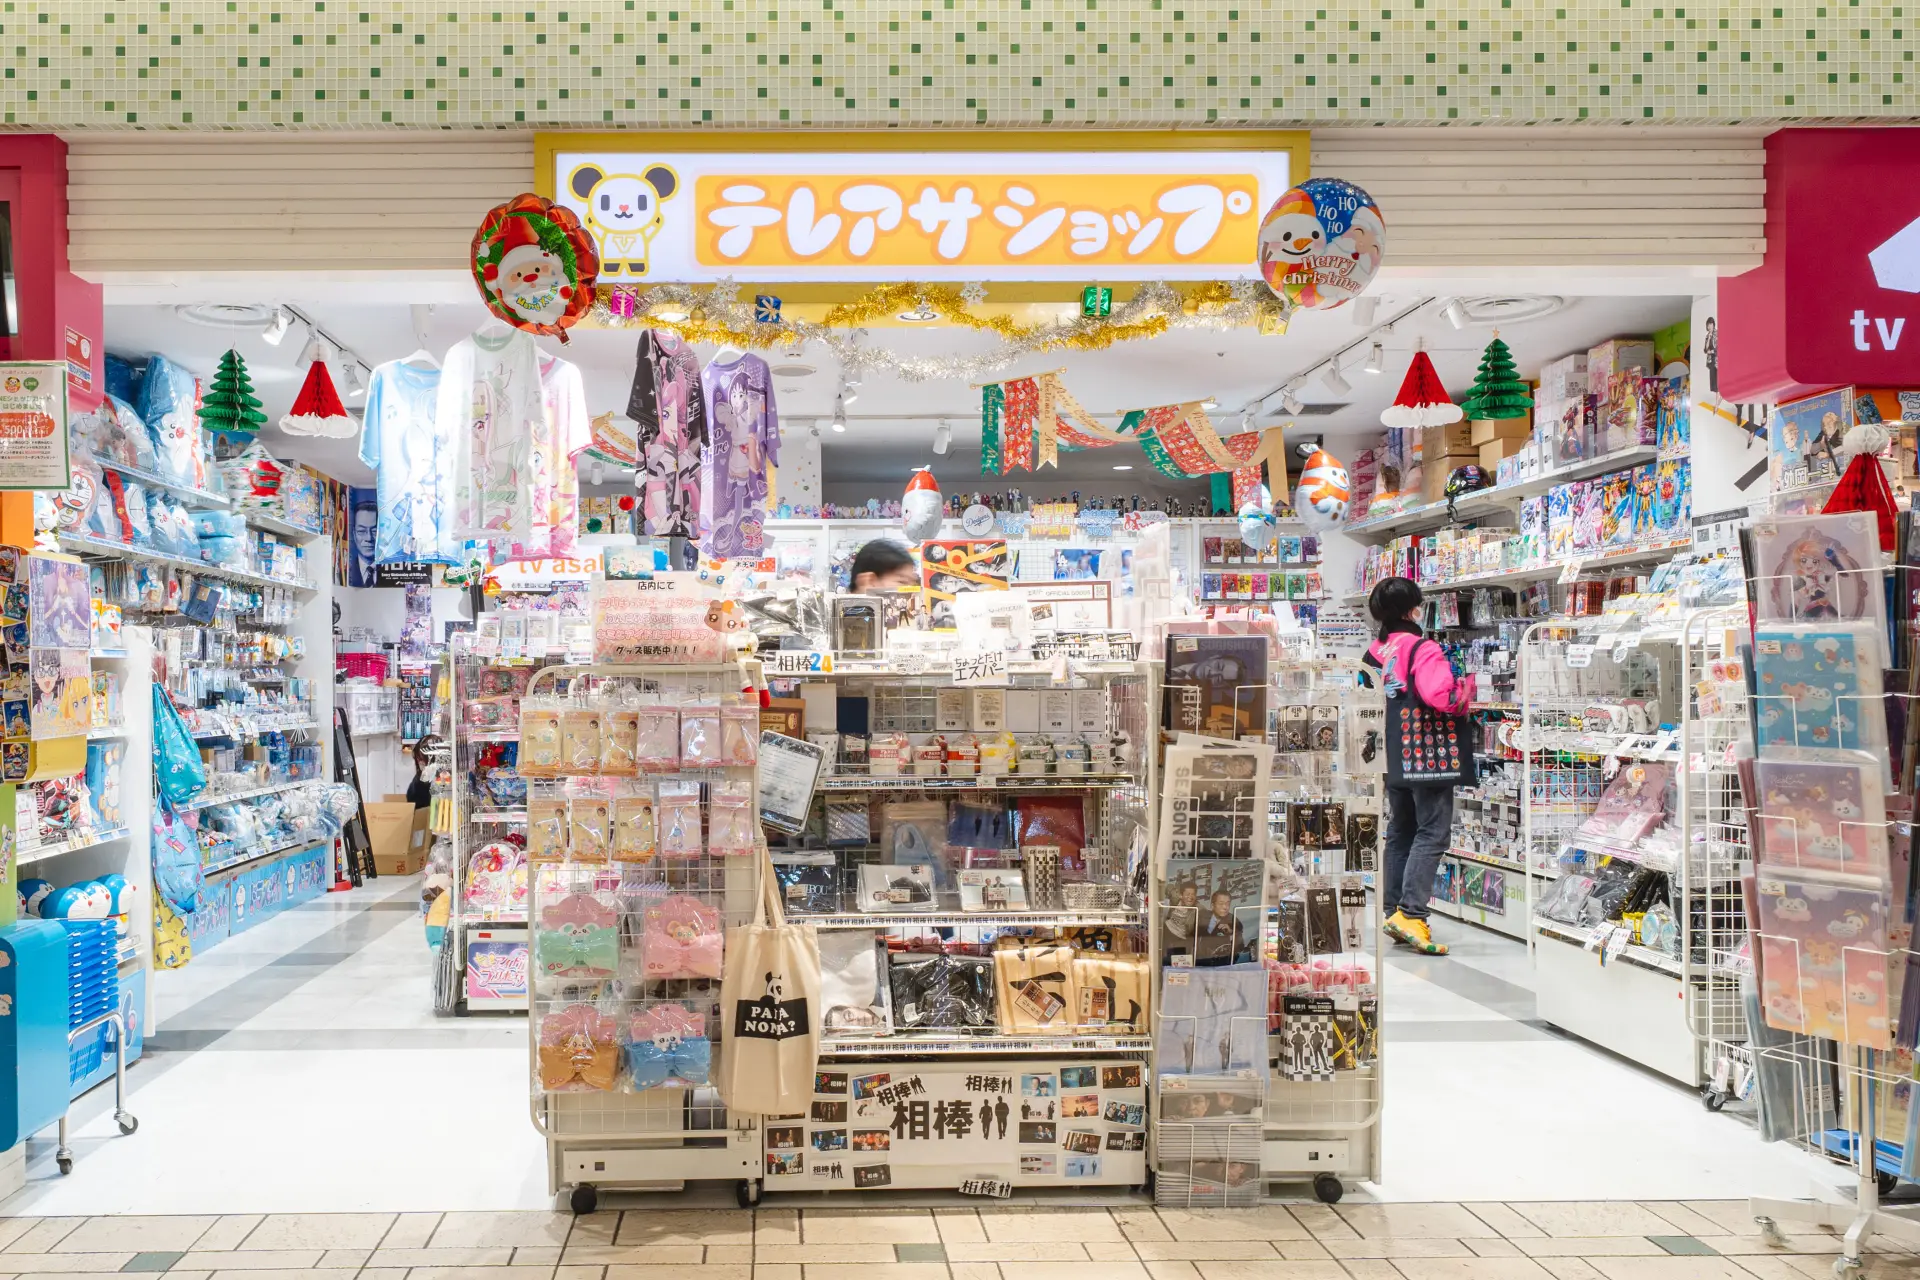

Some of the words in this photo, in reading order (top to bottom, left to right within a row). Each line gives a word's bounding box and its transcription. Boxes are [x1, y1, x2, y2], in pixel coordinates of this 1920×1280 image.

[1338, 196, 1358, 211] HO
[1317, 203, 1338, 220] HO
[708, 184, 1252, 259] テレアサショップ
[1326, 221, 1344, 234] HO
[1300, 254, 1356, 276] Merry
[516, 295, 541, 312] Merry
[1849, 310, 1906, 351] tv
[965, 512, 991, 527] Dodgers
[519, 559, 543, 574] tv
[637, 581, 675, 591] 店内にて
[1200, 640, 1259, 651] SUGISHITA
[954, 652, 1003, 667] ちょっとだけ
[954, 664, 1004, 682] エスパー
[1360, 710, 1377, 718] 相棒
[1173, 766, 1190, 836] SEASON
[1342, 896, 1358, 904] 相棒
[966, 1075, 1000, 1093] 相棒
[1125, 1077, 1138, 1087] 20
[876, 1080, 912, 1107] 相棒
[890, 1100, 974, 1140] 相棒
[813, 1165, 829, 1173] 相棒
[961, 1180, 997, 1194] 相棒
